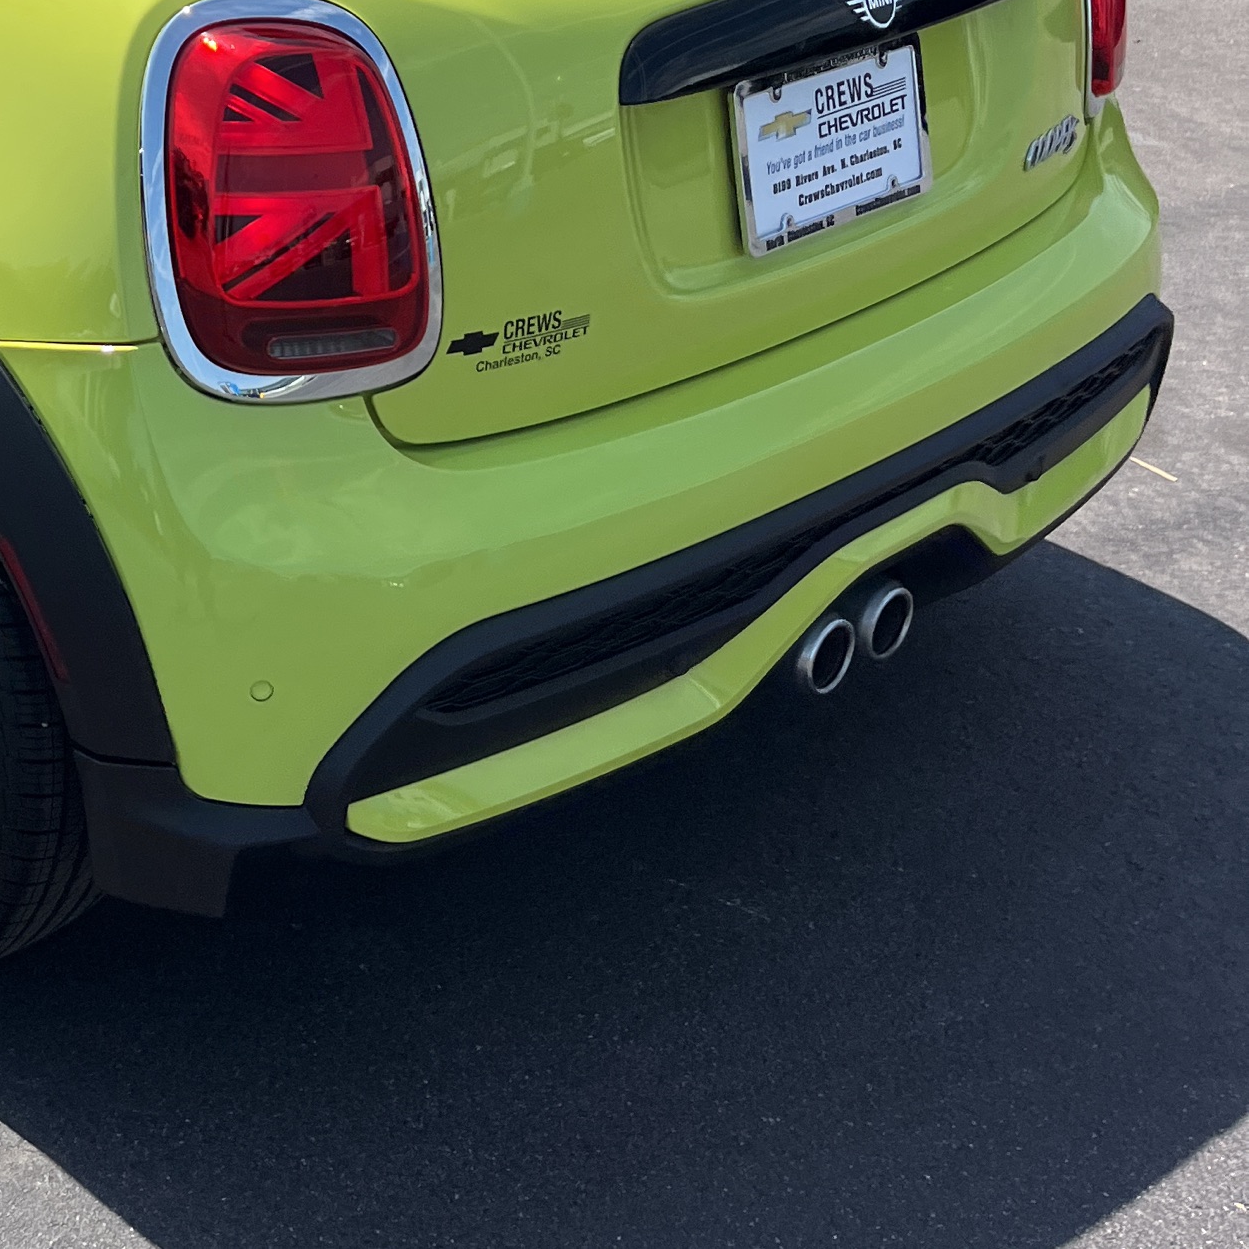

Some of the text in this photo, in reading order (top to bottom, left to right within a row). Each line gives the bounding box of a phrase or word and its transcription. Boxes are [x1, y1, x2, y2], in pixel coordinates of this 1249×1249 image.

[814, 72, 874, 115] CREWS
[818, 94, 908, 139] CHEVROLET
[766, 157, 792, 175] You've
[793, 150, 806, 170] got
[807, 150, 813, 161] a
[814, 138, 834, 158] friend
[835, 136, 843, 150] in
[844, 133, 857, 147] the
[858, 129, 871, 143] car
[795, 170, 819, 187] Rivers
[892, 137, 903, 151] SC
[798, 167, 883, 207] CrewsChevrolet.com
[501, 325, 590, 355] CHEVROLET
[503, 309, 563, 340] CREWS
[475, 344, 562, 373] Charleston, SC
